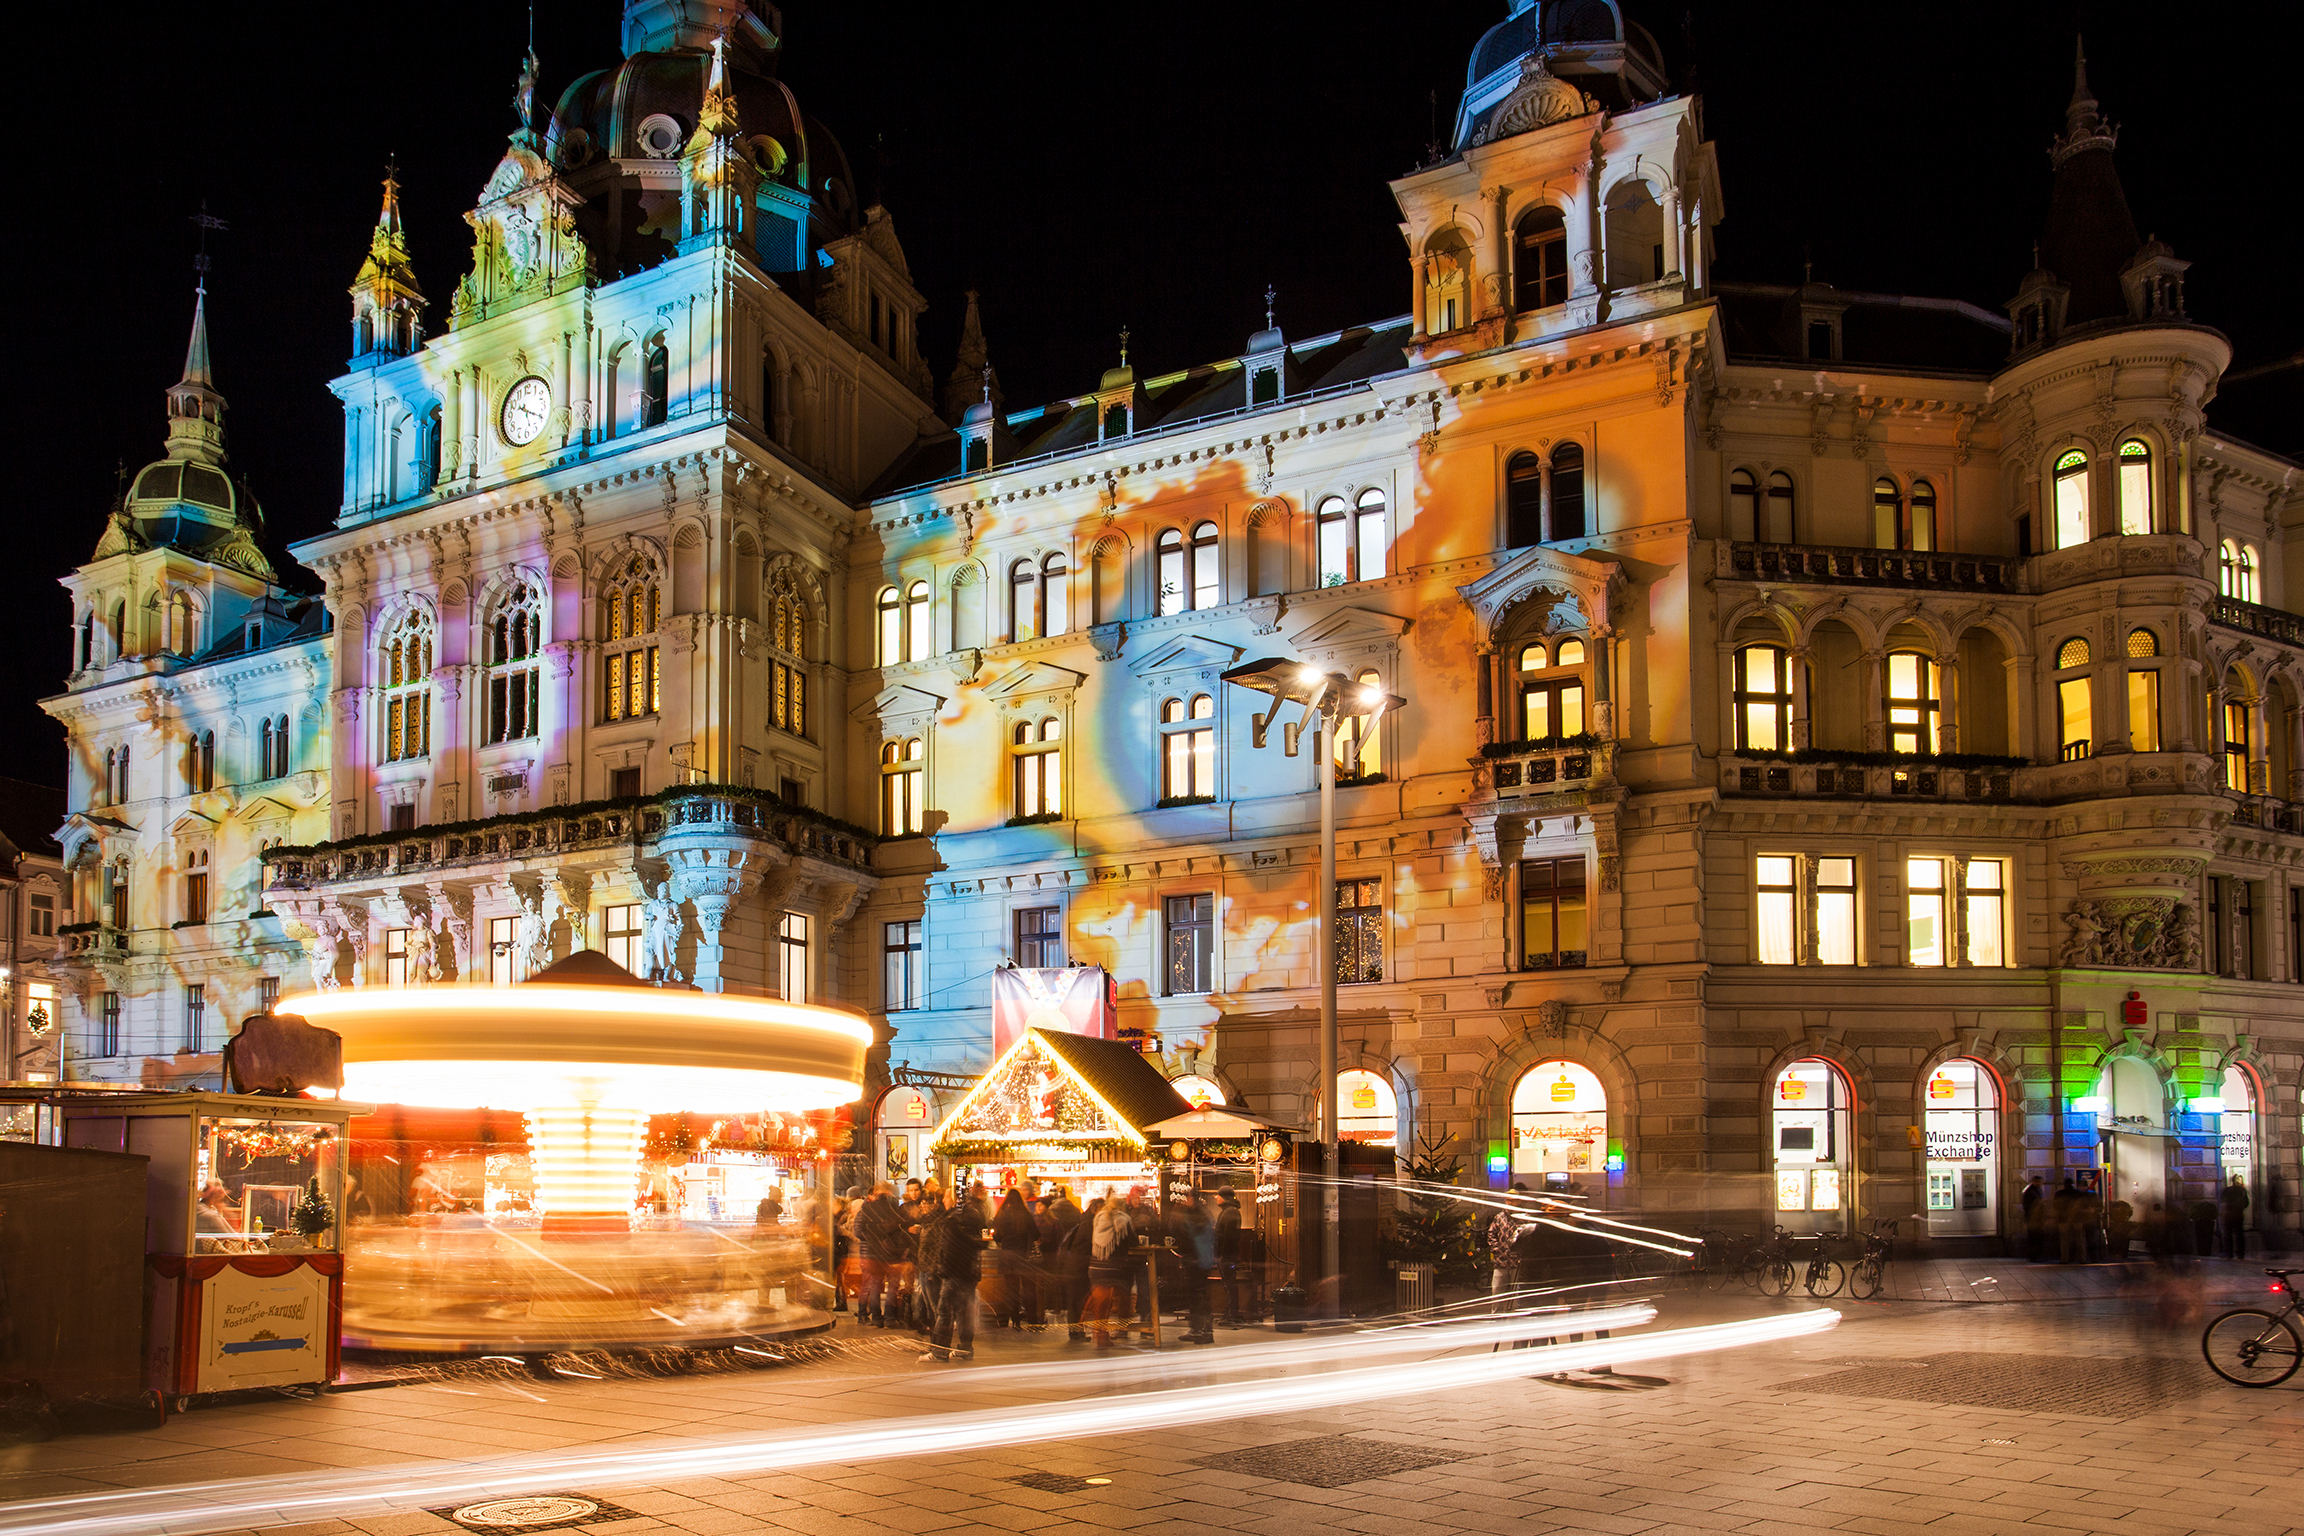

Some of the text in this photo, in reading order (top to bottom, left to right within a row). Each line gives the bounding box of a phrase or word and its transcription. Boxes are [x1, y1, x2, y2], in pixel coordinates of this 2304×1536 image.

[1926, 1130, 1993, 1145] Münzshop
[2223, 1131, 2251, 1144] nzshop
[1926, 1145, 1992, 1160] Exchange
[2220, 1145, 2250, 1158] change
[222, 1296, 310, 1329] Nostalgie-Karussell
